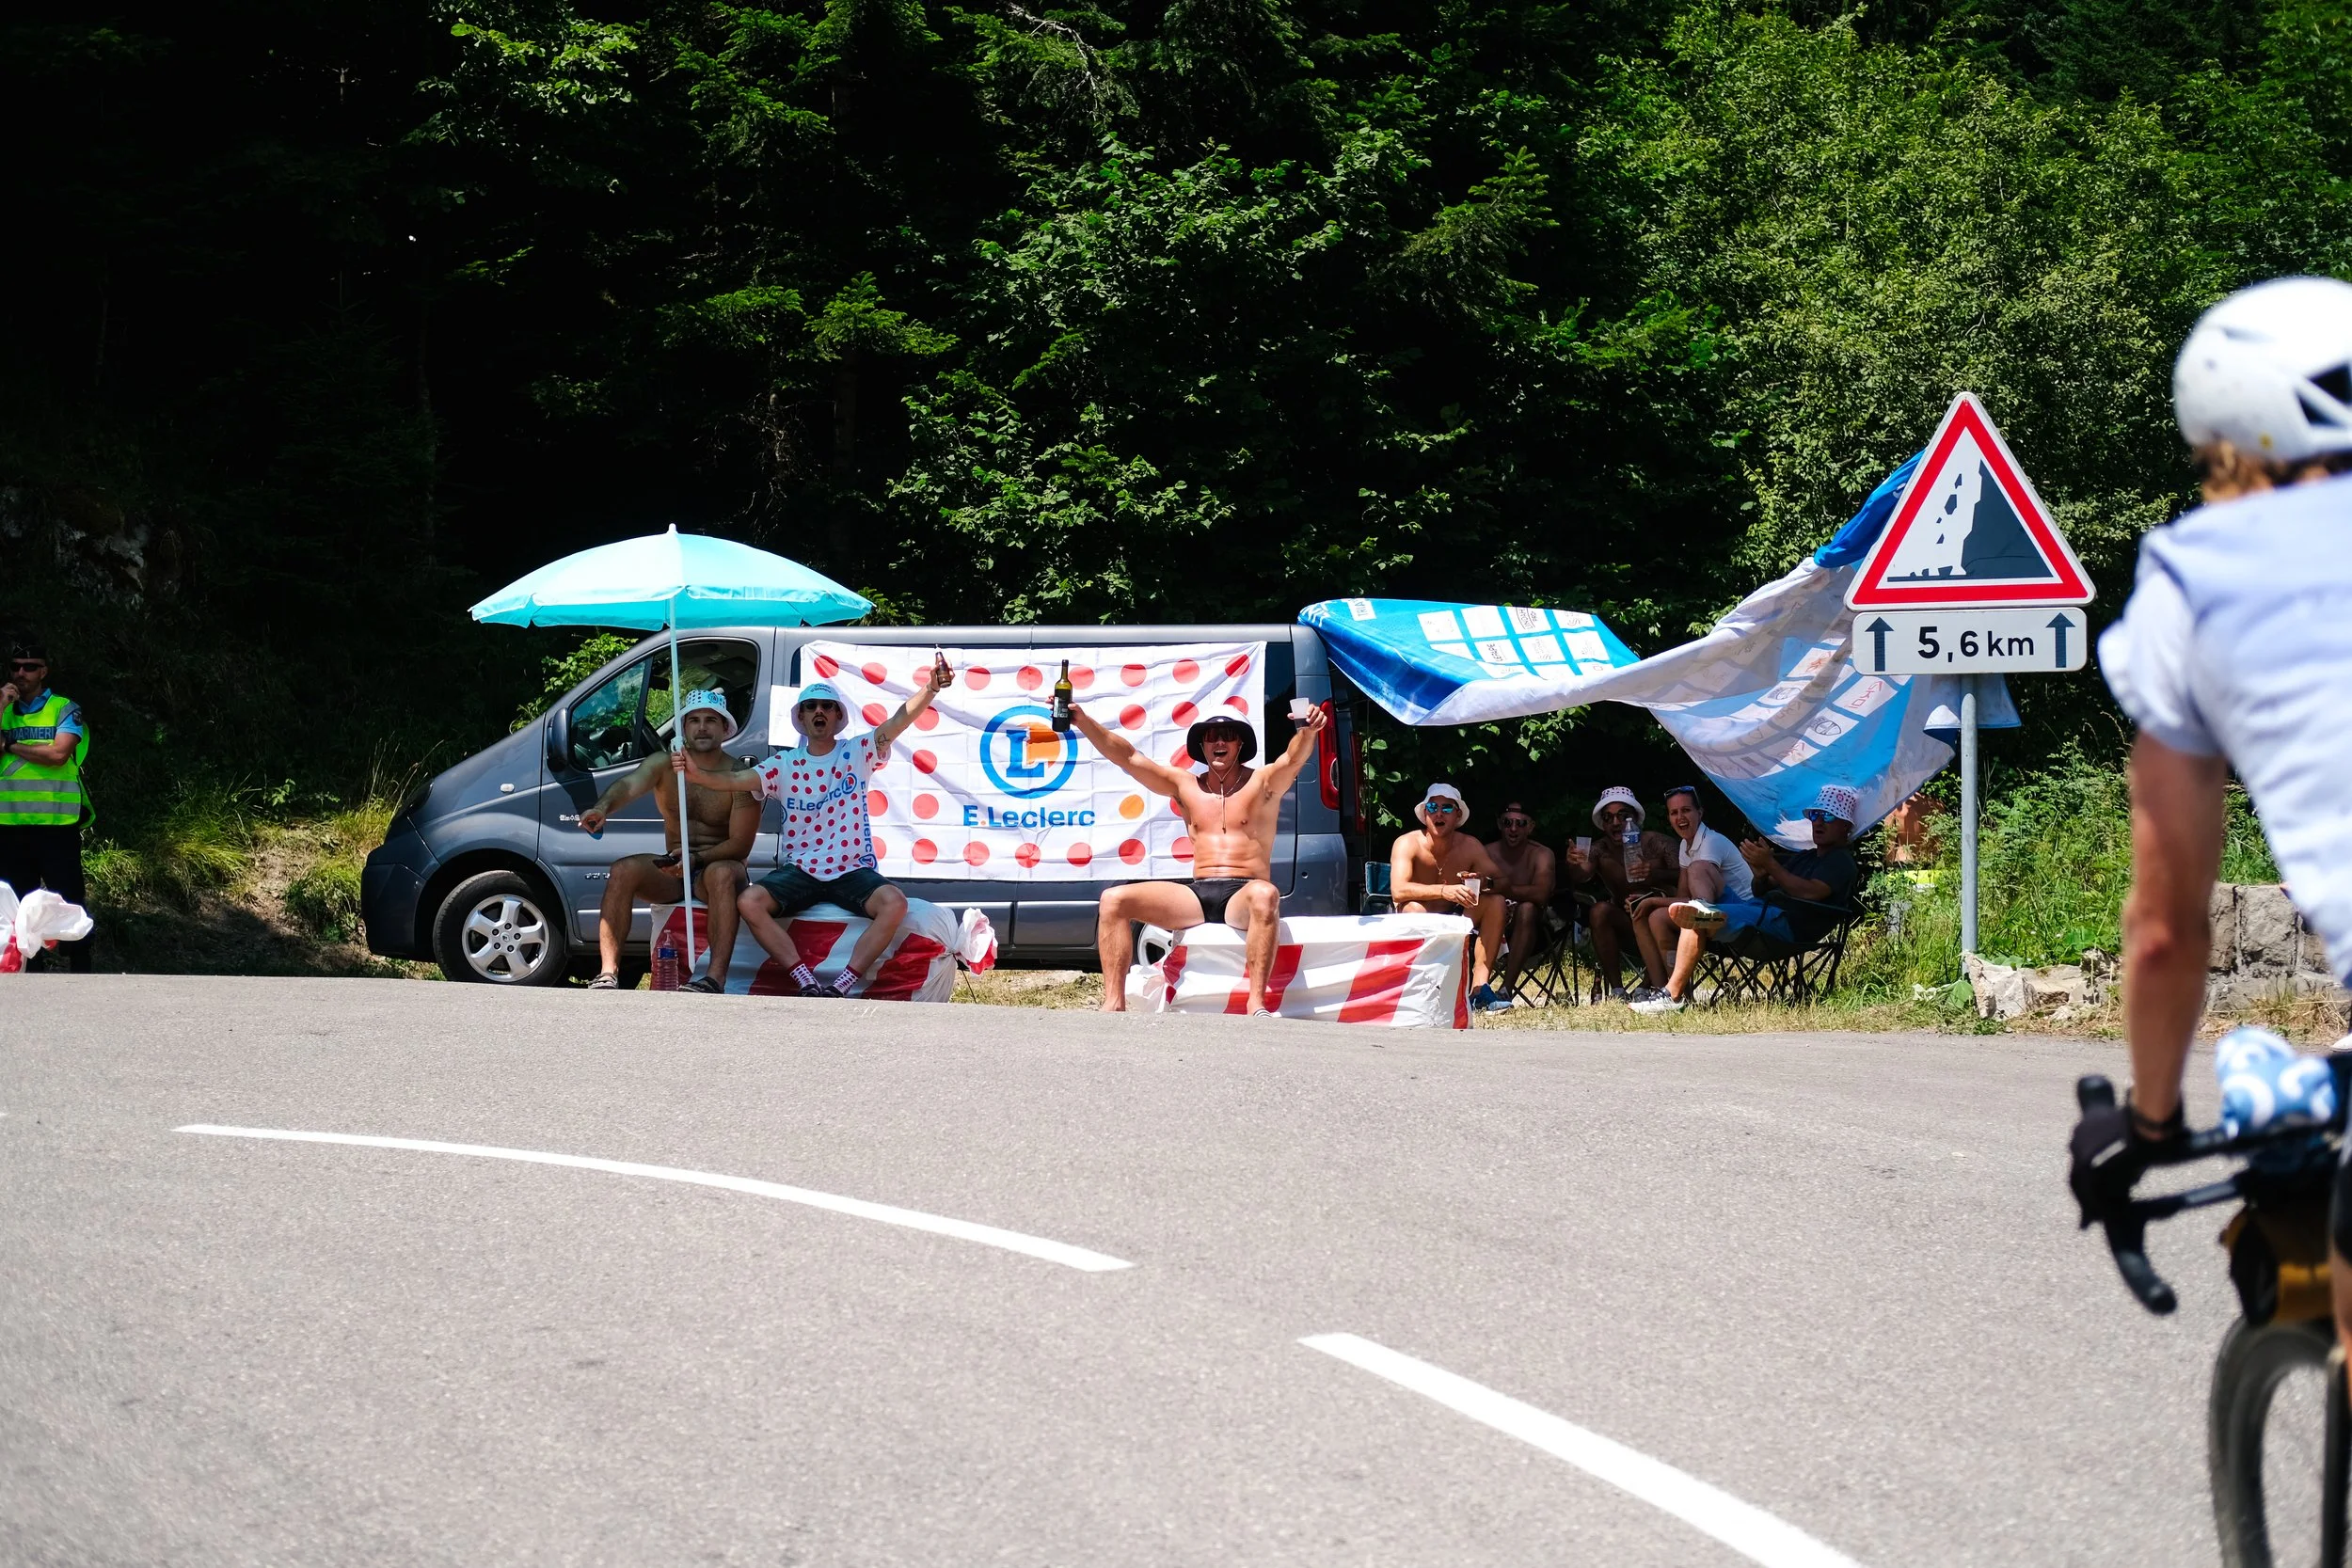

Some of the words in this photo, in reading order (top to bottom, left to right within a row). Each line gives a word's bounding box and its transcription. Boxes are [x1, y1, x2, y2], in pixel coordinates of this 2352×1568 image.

[1354, 599, 1369, 617] TRIA
[1917, 626, 1979, 663] 5,6
[1987, 630, 2035, 657] km
[963, 804, 1096, 828] E.Leclerc
